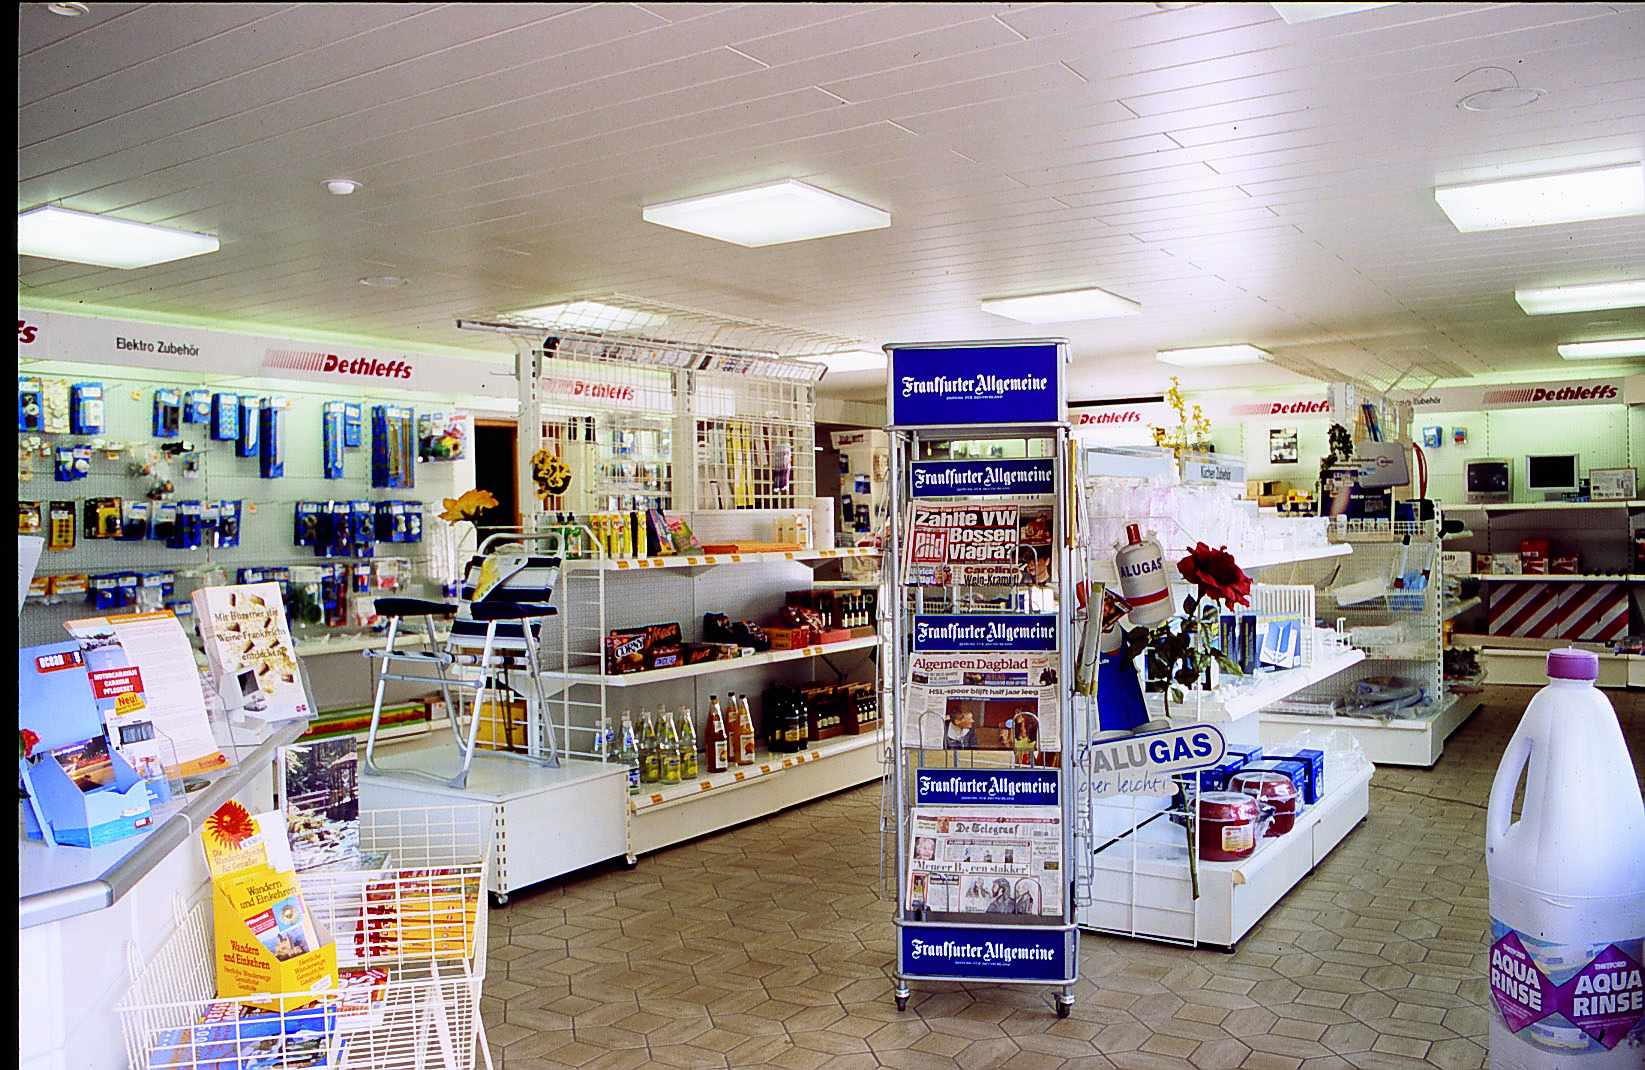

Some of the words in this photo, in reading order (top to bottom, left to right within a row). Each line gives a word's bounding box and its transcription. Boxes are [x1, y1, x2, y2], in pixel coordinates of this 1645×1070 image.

[116, 337, 155, 352] Elektro
[158, 341, 199, 357] Zubehör
[323, 354, 412, 379] Dethleffs
[902, 376, 974, 397] Frankfurter
[975, 374, 1047, 395] Allgemeine
[1532, 384, 1618, 401] Dethleffs
[1080, 411, 1140, 425] Dethleffs
[915, 468, 983, 488] Frankfurter
[983, 466, 1051, 487] Allgemeine
[916, 511, 977, 527] Zahlte
[982, 511, 1017, 526] VW
[915, 532, 946, 558] Bild
[950, 528, 1016, 543] Bossen
[949, 543, 1016, 560] Viagra?
[1120, 557, 1162, 578] ALUGAS
[652, 625, 677, 642] Mars
[918, 623, 985, 643] Frankfurter
[986, 622, 1054, 642] Allgemeine
[615, 636, 645, 659] CORNY
[913, 659, 975, 671] Algemeen
[976, 658, 1028, 672] Dagblad
[118, 694, 138, 706] Neu!
[928, 689, 969, 697] HSL-spoor
[971, 688, 988, 696] blijft
[1094, 733, 1212, 773] ALUGAS
[920, 776, 987, 796] Frankfurter
[988, 777, 1056, 796] Allgemeine
[955, 823, 970, 833] De
[971, 823, 1020, 836] Telegraaf
[239, 897, 255, 909] und
[256, 887, 297, 904] Einkehren
[247, 881, 282, 896] Wandern
[231, 940, 259, 956] Wandern
[912, 939, 982, 960] Frankfurter
[983, 942, 1054, 962] Allgemeine
[223, 953, 235, 963] und
[236, 954, 270, 970] Einkehren
[1492, 949, 1541, 990] AQUA
[1492, 967, 1542, 1011] RINSE
[1574, 970, 1643, 995] AQUA
[1573, 990, 1643, 1017] RINSE
